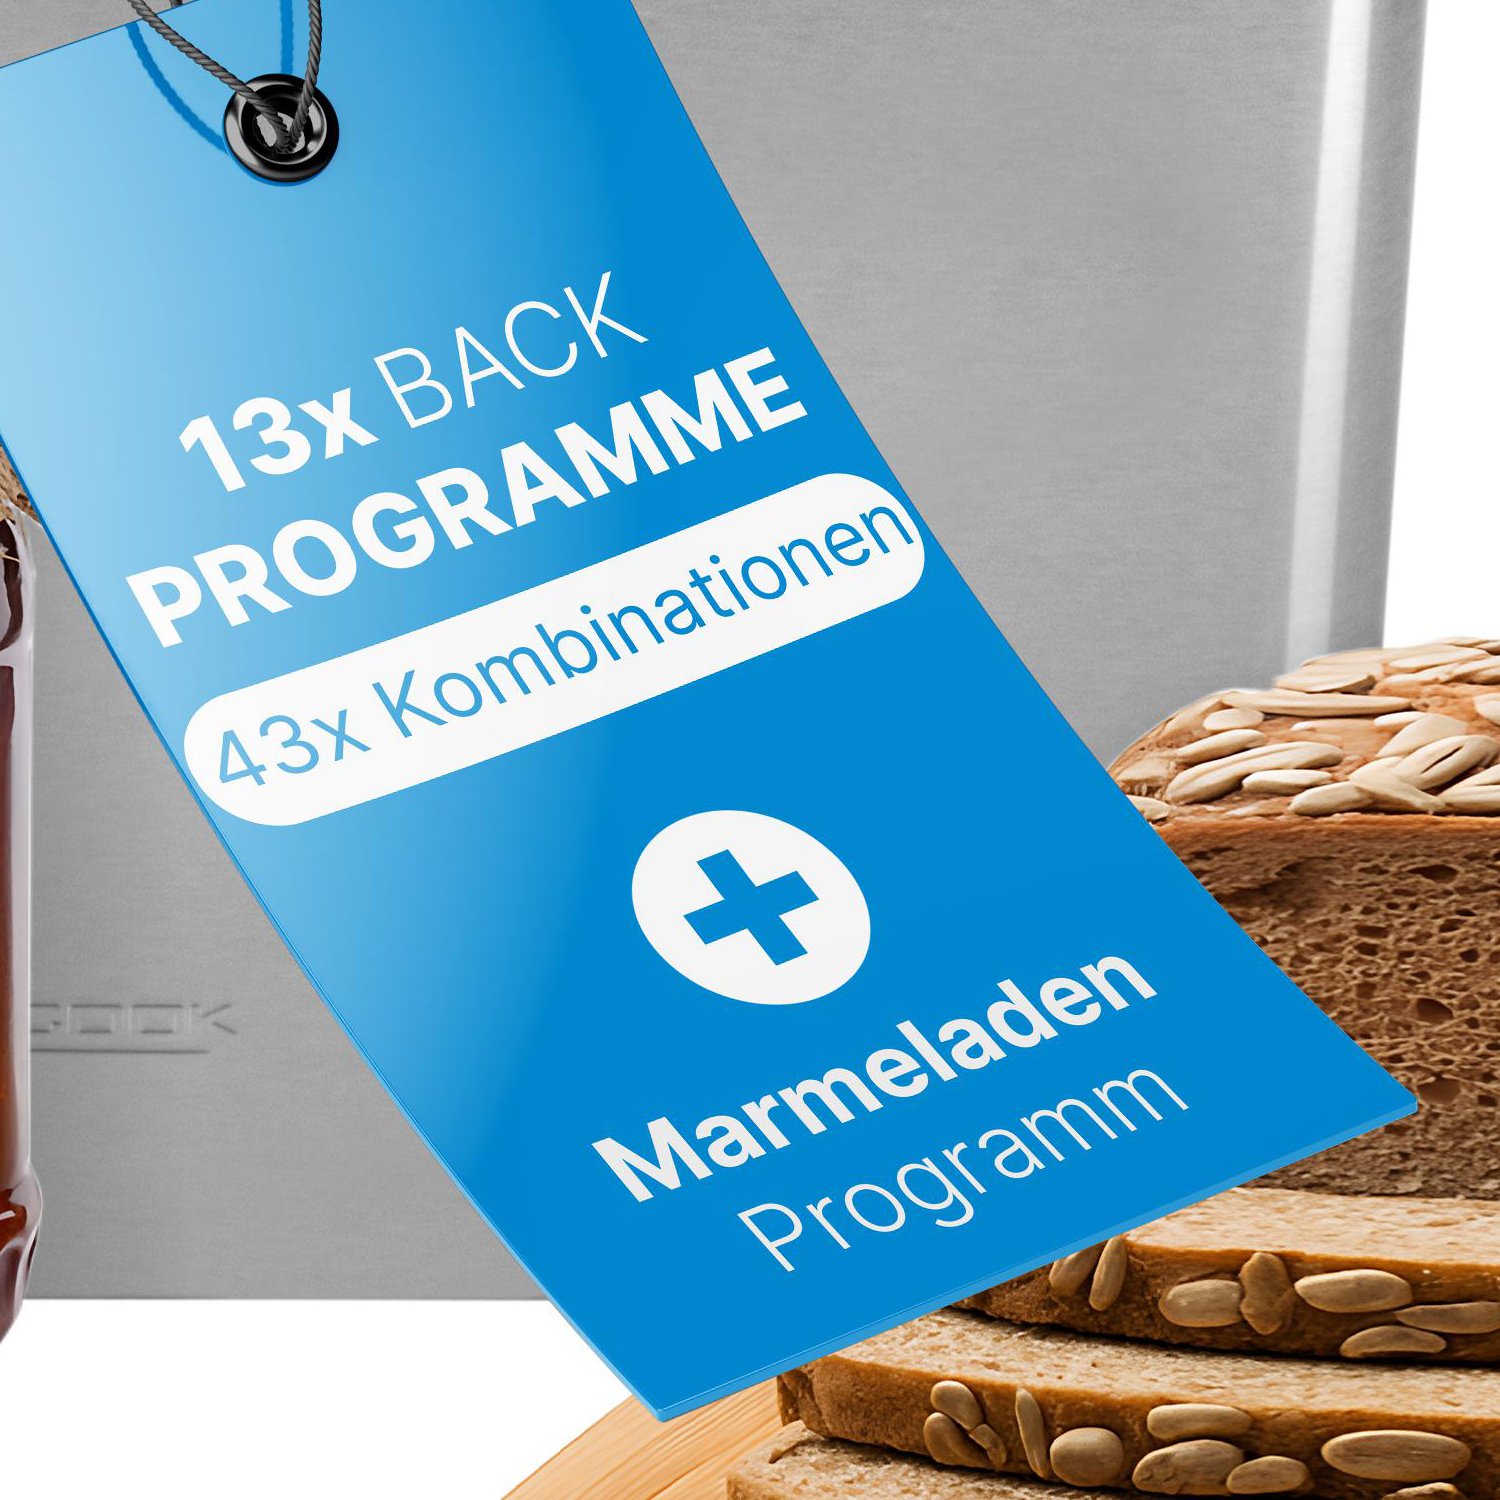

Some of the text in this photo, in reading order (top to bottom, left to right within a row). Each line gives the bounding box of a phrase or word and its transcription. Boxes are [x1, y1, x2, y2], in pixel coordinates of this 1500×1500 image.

[124, 345, 809, 649] PROGRAMME
[178, 270, 650, 493] 13x BACK
[217, 503, 915, 791] 43x Kombinationen
[590, 955, 1159, 1203] Marmeladen
[736, 1068, 1191, 1273] Programm
